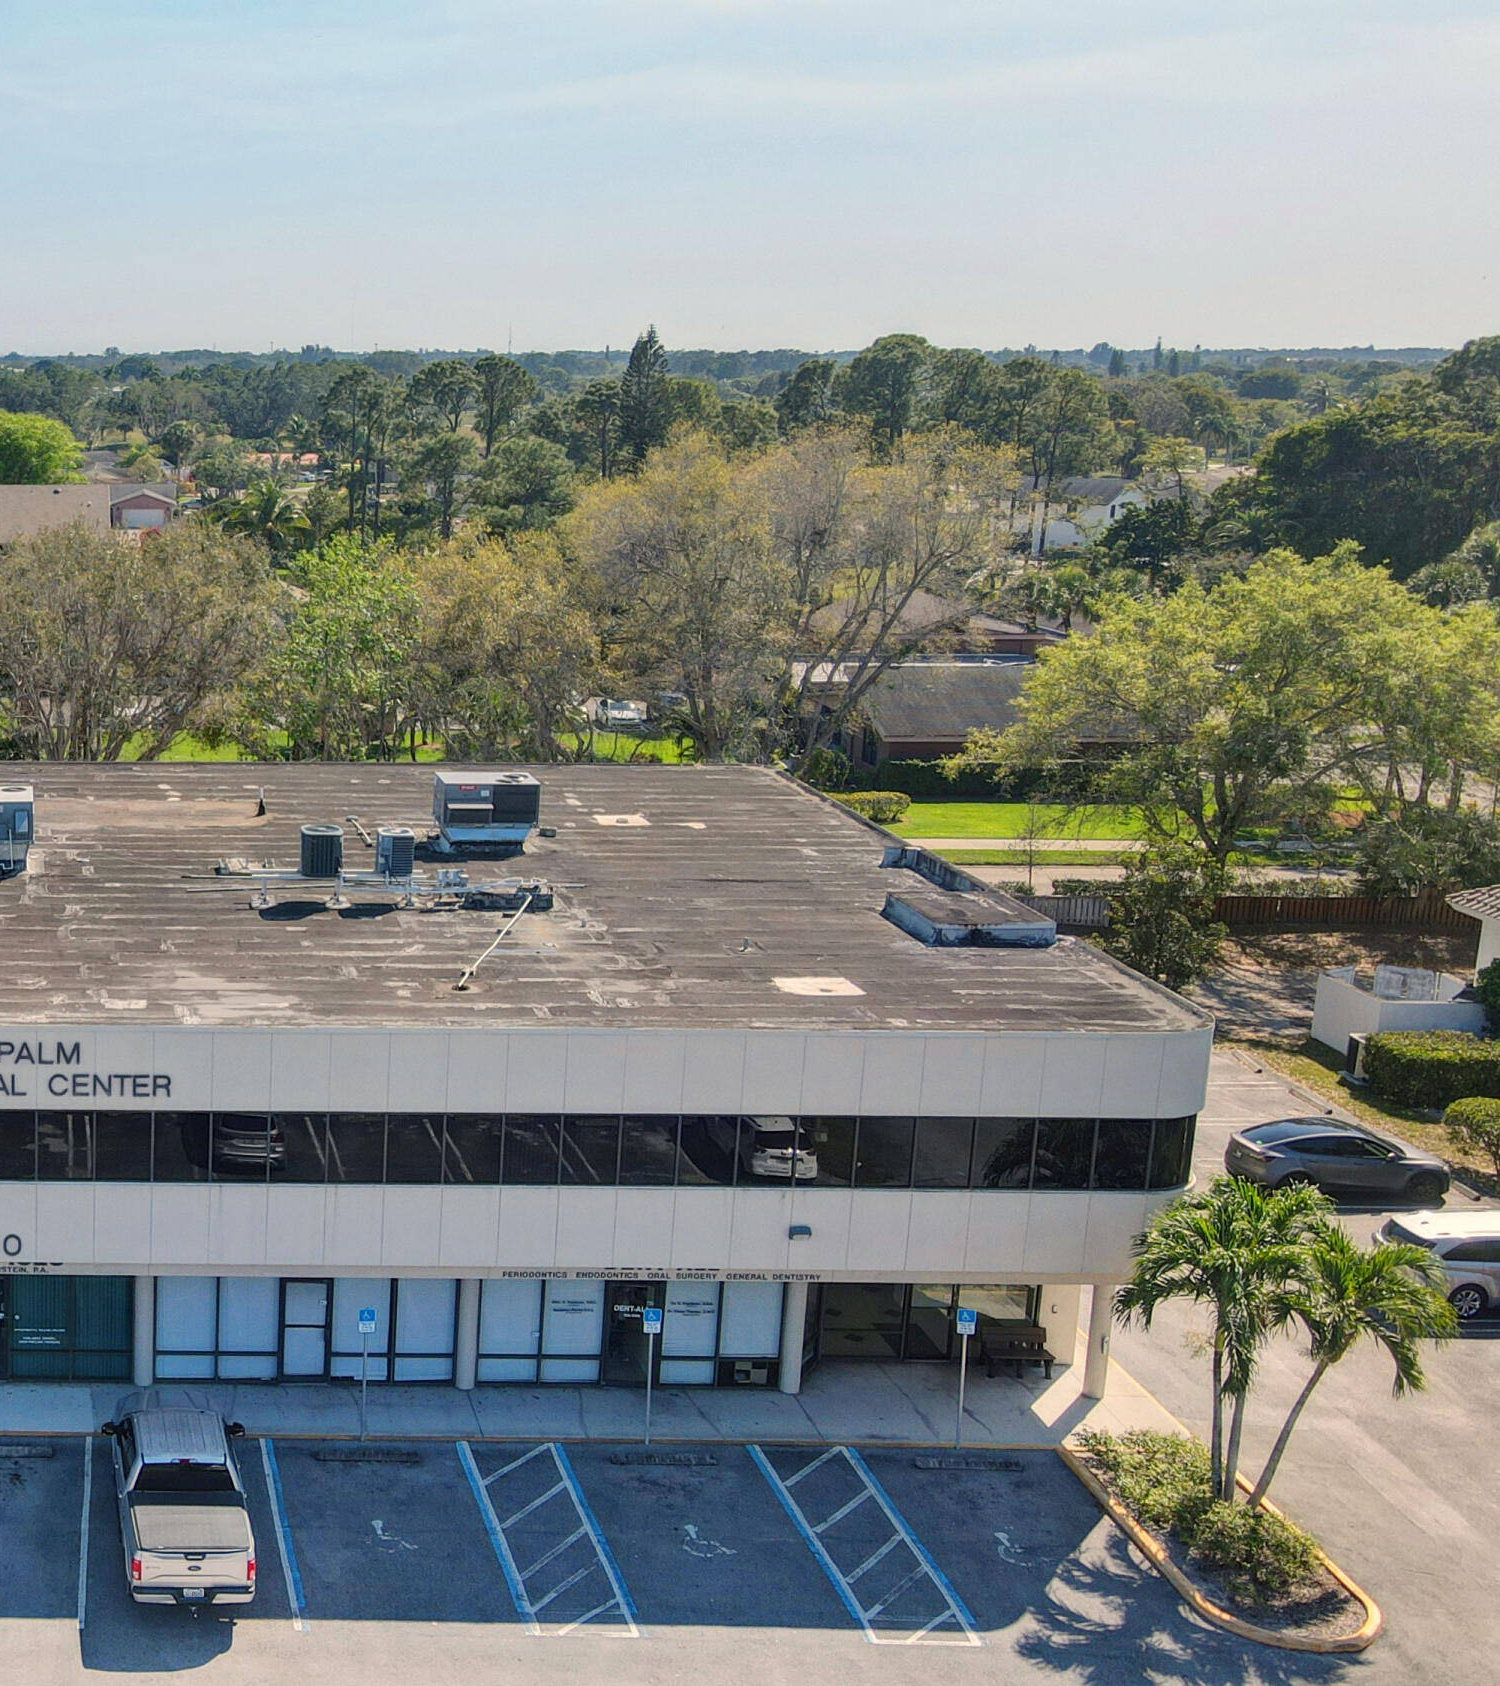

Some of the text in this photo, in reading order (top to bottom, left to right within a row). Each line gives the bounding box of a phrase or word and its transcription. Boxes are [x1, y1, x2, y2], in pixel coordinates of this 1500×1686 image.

[48, 1073, 172, 1098] CENTER
[502, 1271, 821, 1282] PERIODONTICS ENDODONTICS ORAL SURGERY GENERAL DENTISTRY
